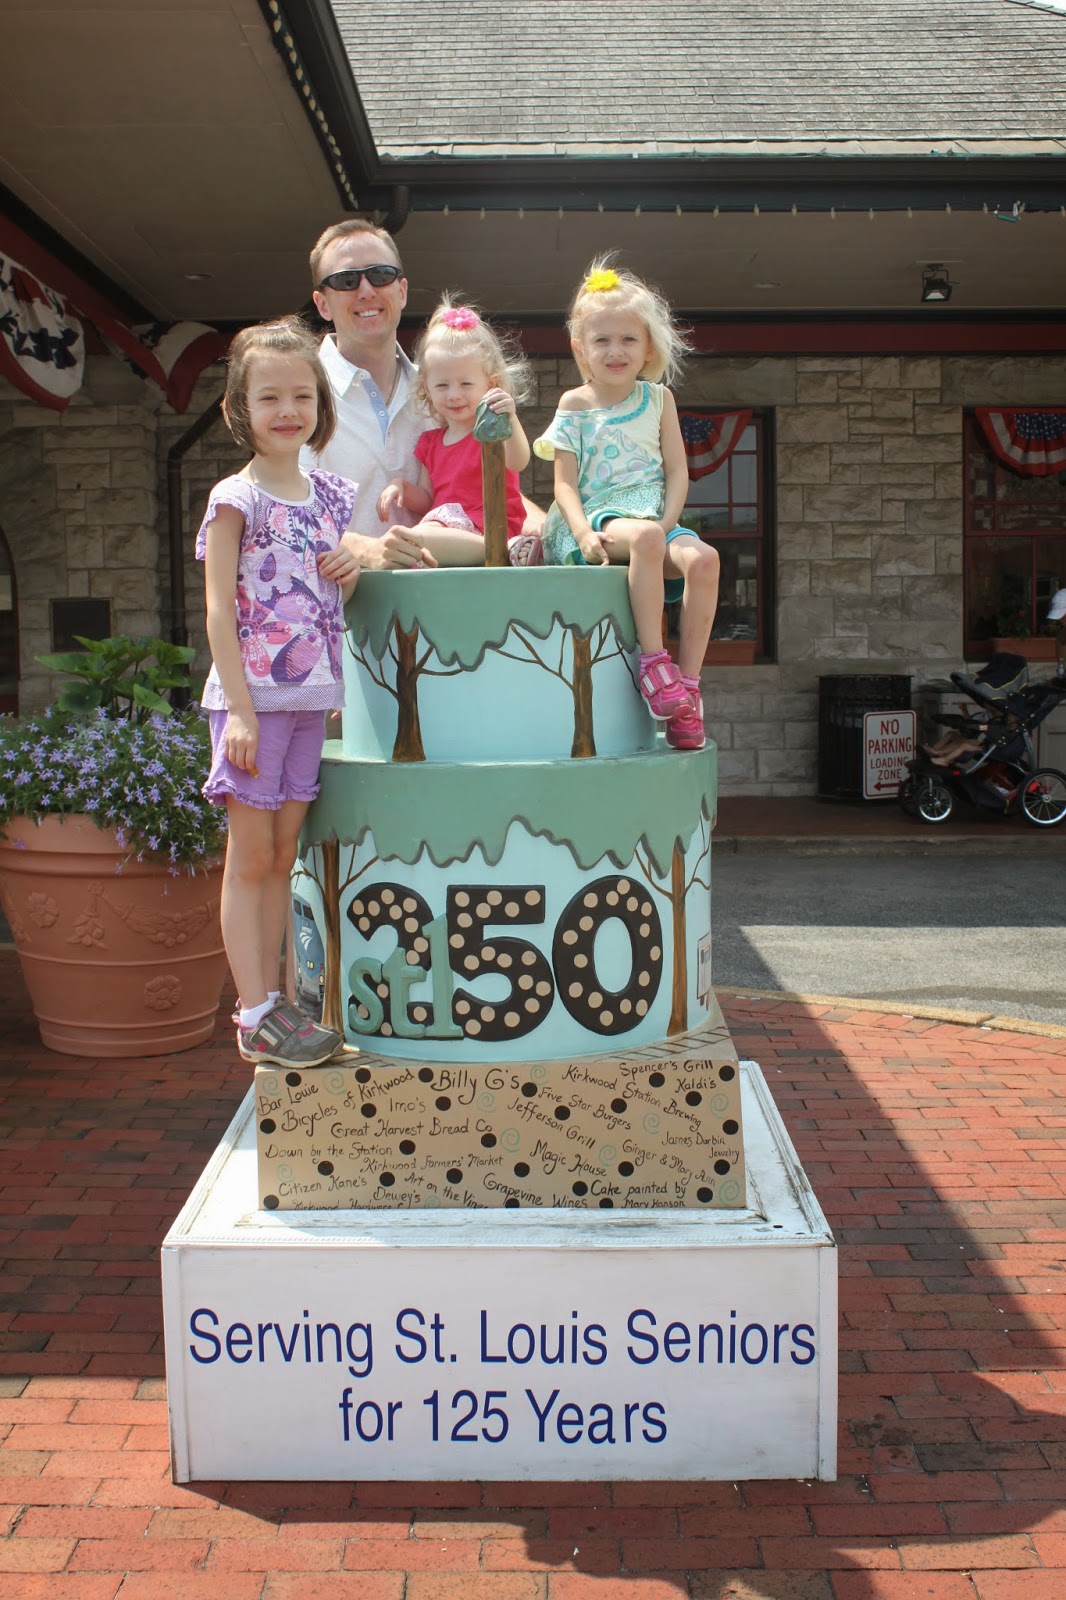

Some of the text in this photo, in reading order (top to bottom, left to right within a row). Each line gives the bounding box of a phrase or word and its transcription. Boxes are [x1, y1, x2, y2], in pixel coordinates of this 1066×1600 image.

[881, 719, 900, 735] NO
[868, 737, 912, 754] PARKING
[878, 768, 902, 780] ZONE
[347, 874, 664, 1042] 250
[618, 1060, 714, 1081] Spencer's Grill
[430, 1068, 520, 1105] Billy G's
[675, 1077, 717, 1094] Kaldi's
[258, 1084, 319, 1116] Bar Louie
[281, 1068, 416, 1137] Bicycles of Kirkwood
[390, 1097, 426, 1113] Imo's
[538, 1086, 632, 1131] Five Star Burgers
[561, 1064, 702, 1132] Kirkwood Station Brewing
[331, 1116, 493, 1139] Great Harvest Bread Co
[508, 1098, 596, 1150] Jefferson Grill
[661, 1131, 726, 1148] James Durbin
[265, 1142, 393, 1164] Down by the Station
[360, 1158, 416, 1174] Kirkwood
[468, 1154, 504, 1168] Market
[530, 1139, 607, 1176] Magic House
[622, 1139, 716, 1187] Ginger & Mary Ann
[708, 1147, 740, 1164] Jewelry
[278, 1175, 368, 1196] Citizen Kane's
[404, 1172, 424, 1186] Art
[426, 1182, 438, 1193] on
[443, 1186, 460, 1201] the
[483, 1172, 588, 1208] Grapevine Wines
[590, 1180, 686, 1200] Cake painted by
[373, 1186, 421, 1209] Dewey's
[622, 1198, 686, 1208] Mary Hanson
[190, 1308, 816, 1378] Serving St. Louis Seniors
[338, 1387, 667, 1444] for 125 Years
